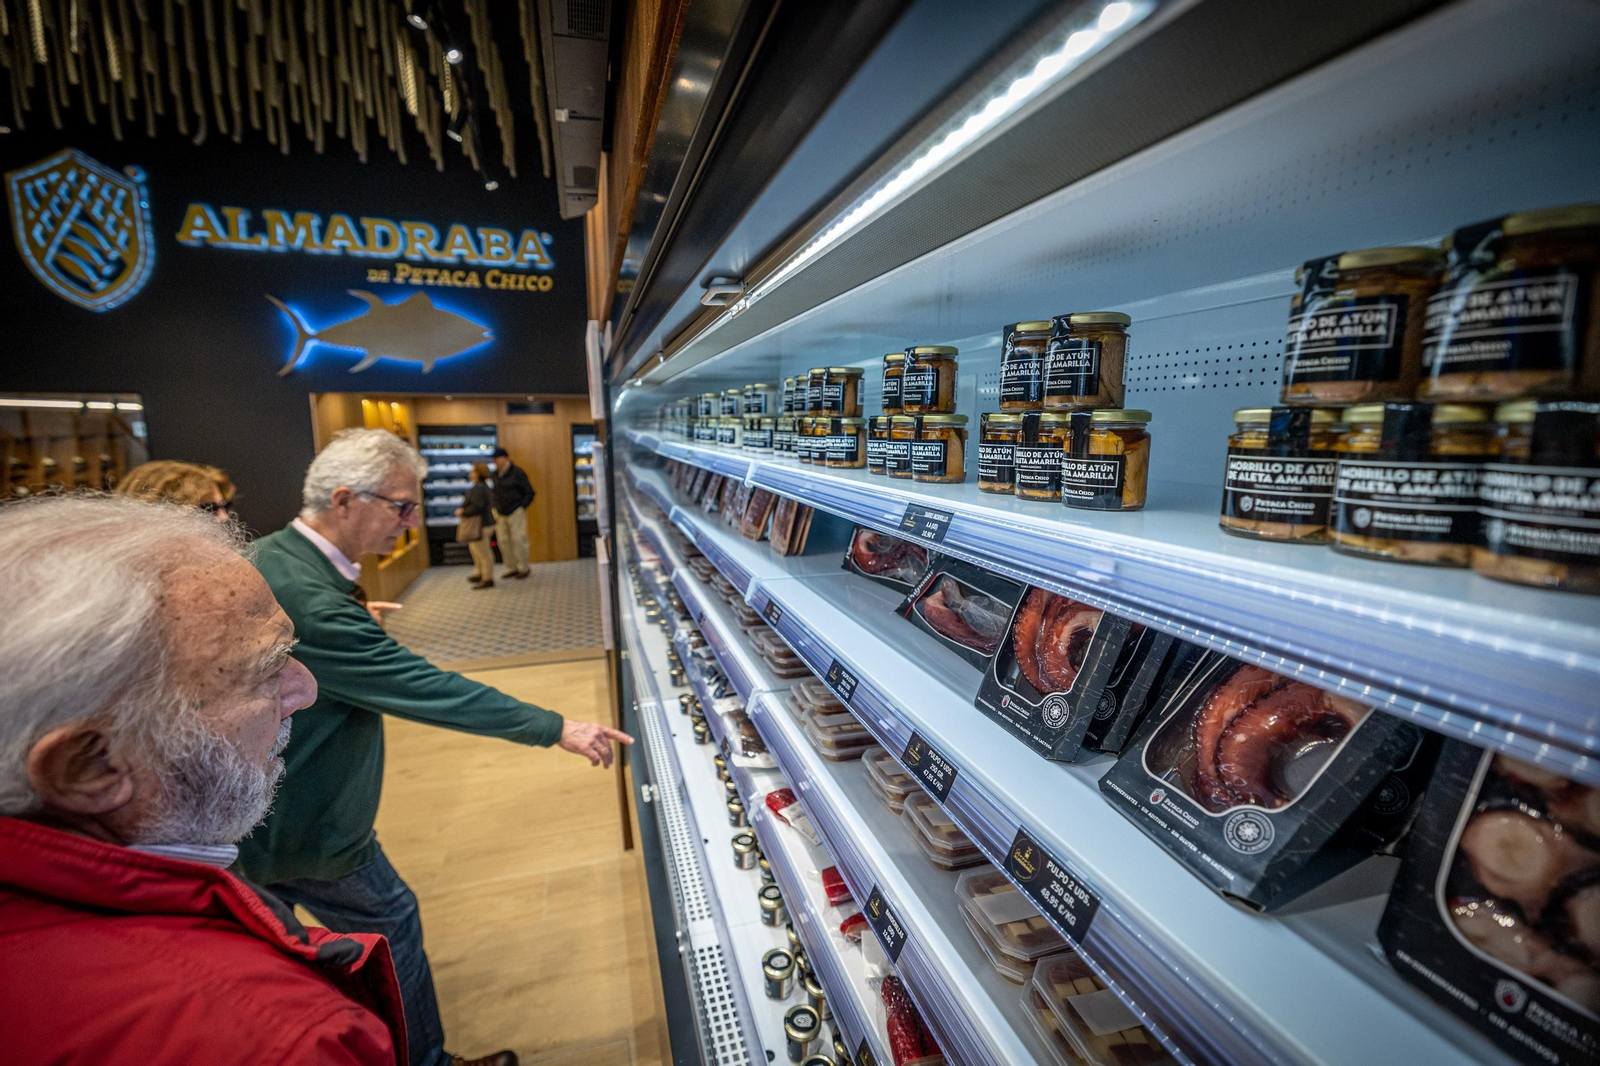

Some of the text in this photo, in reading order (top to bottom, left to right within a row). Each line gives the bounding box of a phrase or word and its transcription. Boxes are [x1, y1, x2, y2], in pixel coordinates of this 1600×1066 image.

[175, 203, 553, 269] ALMADRABA
[366, 263, 553, 292] DE PETACA CHICO
[1339, 310, 1389, 326] ATÚN
[1066, 350, 1091, 360] ATÚN
[1052, 360, 1091, 369] AMARILLA
[1072, 471, 1114, 480] AMARILLA
[1088, 464, 1114, 472] ATÚN
[1230, 461, 1335, 476] MORRILLO DE ATÚ
[1228, 470, 1334, 486] DE ALETA AMARILL
[1255, 498, 1316, 510] PETACA CHICO
[928, 750, 941, 764] PULPO
[1164, 798, 1200, 826] PETACA CHICO
[1111, 783, 1138, 806] CONSERVANTES
[1148, 812, 1168, 829] ADITIVOS
[1171, 830, 1180, 838] SIN
[1202, 853, 1211, 863] SIN
[1210, 860, 1235, 881] LACTOSA
[1046, 860, 1068, 884] PULPO
[1068, 882, 1074, 890] 2
[1074, 886, 1090, 906] UDS.
[1050, 881, 1074, 909] 250 GR.
[1041, 888, 1076, 926] 48,95 €/KG
